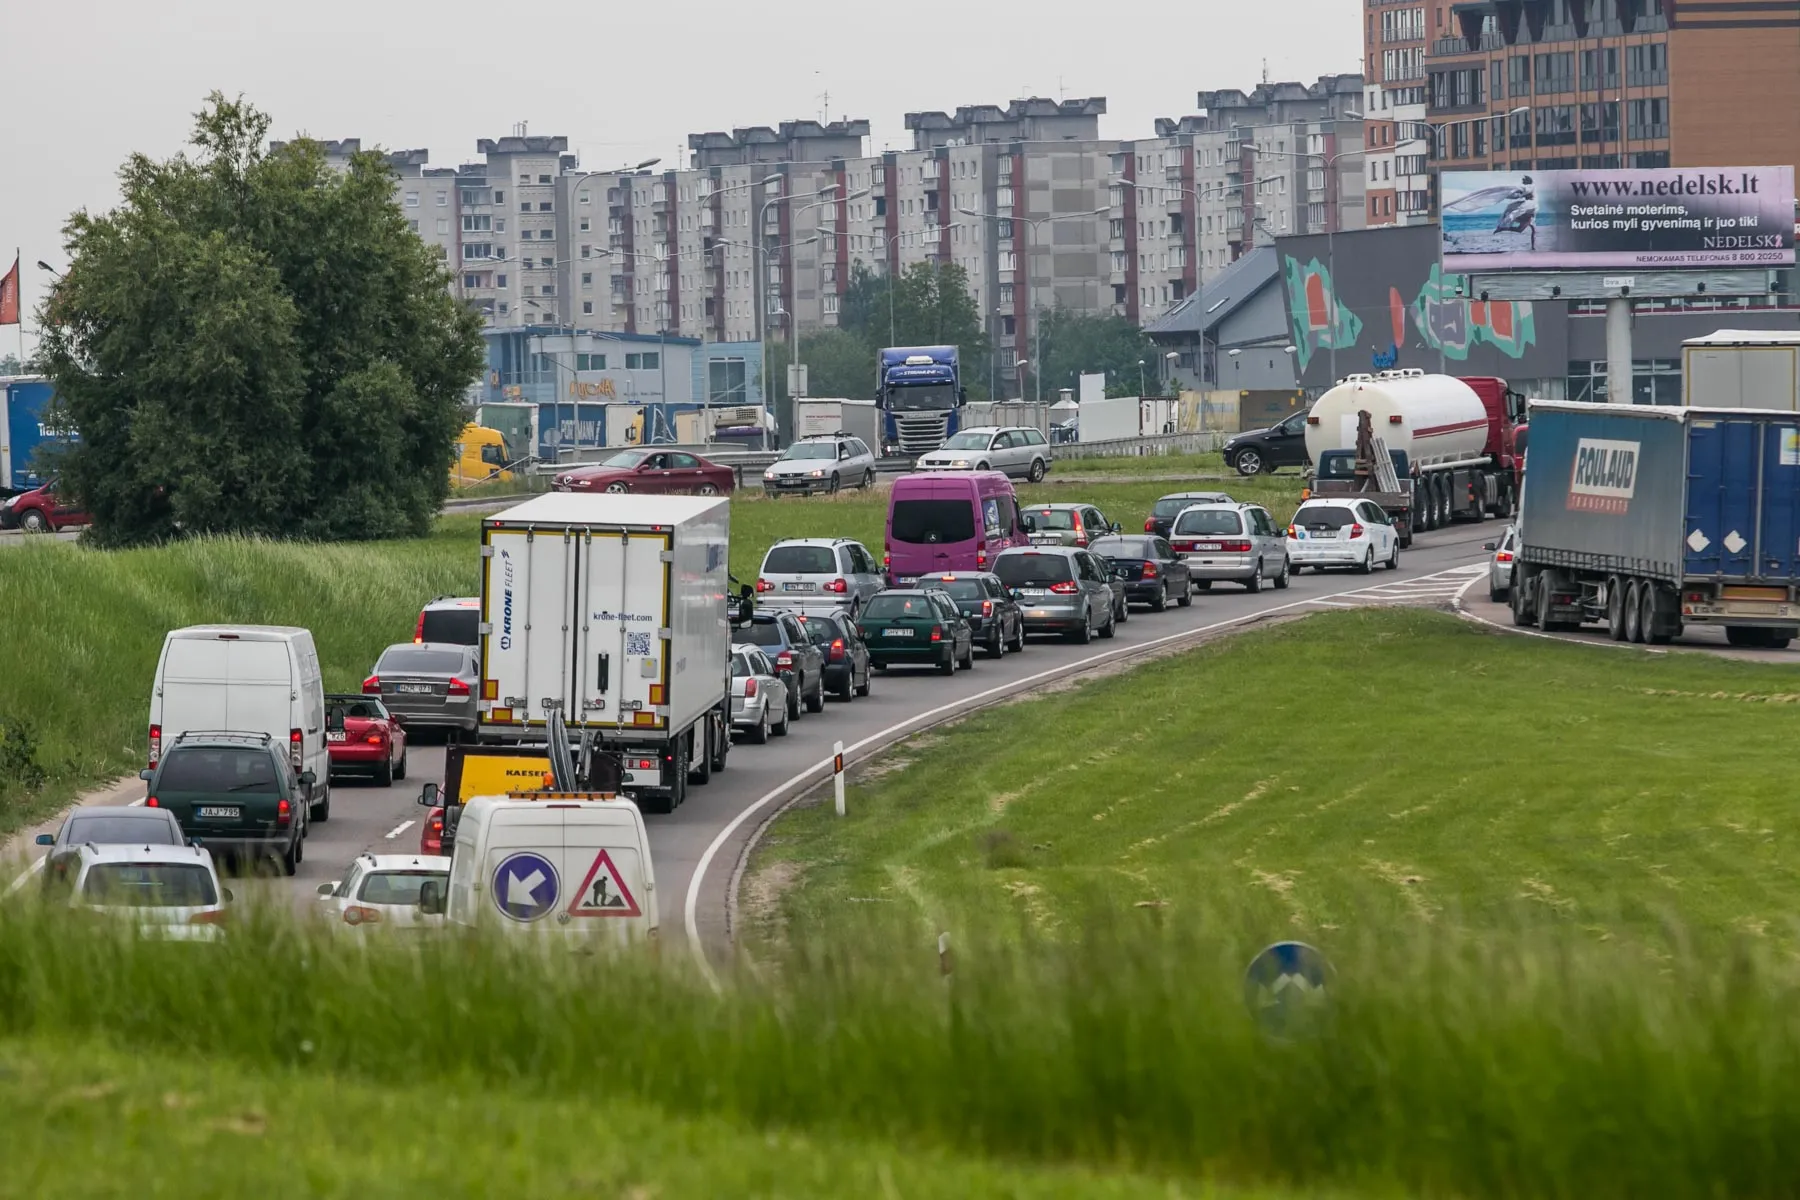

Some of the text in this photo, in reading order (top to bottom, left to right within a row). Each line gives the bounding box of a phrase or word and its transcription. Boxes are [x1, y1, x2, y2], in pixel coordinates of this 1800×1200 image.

[1571, 173, 1759, 196] www.nedelsk.lt
[1570, 204, 1689, 216] Svetainė moterims,
[1571, 216, 1758, 231] kurios myli gyvenimą ir juo tiki
[1703, 234, 1775, 249] NEDELSK
[1731, 253, 1738, 261] 8
[1739, 253, 1755, 261] 800
[1757, 252, 1784, 260] 20250
[1575, 447, 1635, 488] ROULAUD
[504, 560, 513, 635] KRONE FLEET
[593, 611, 653, 622] krone-fleet.com
